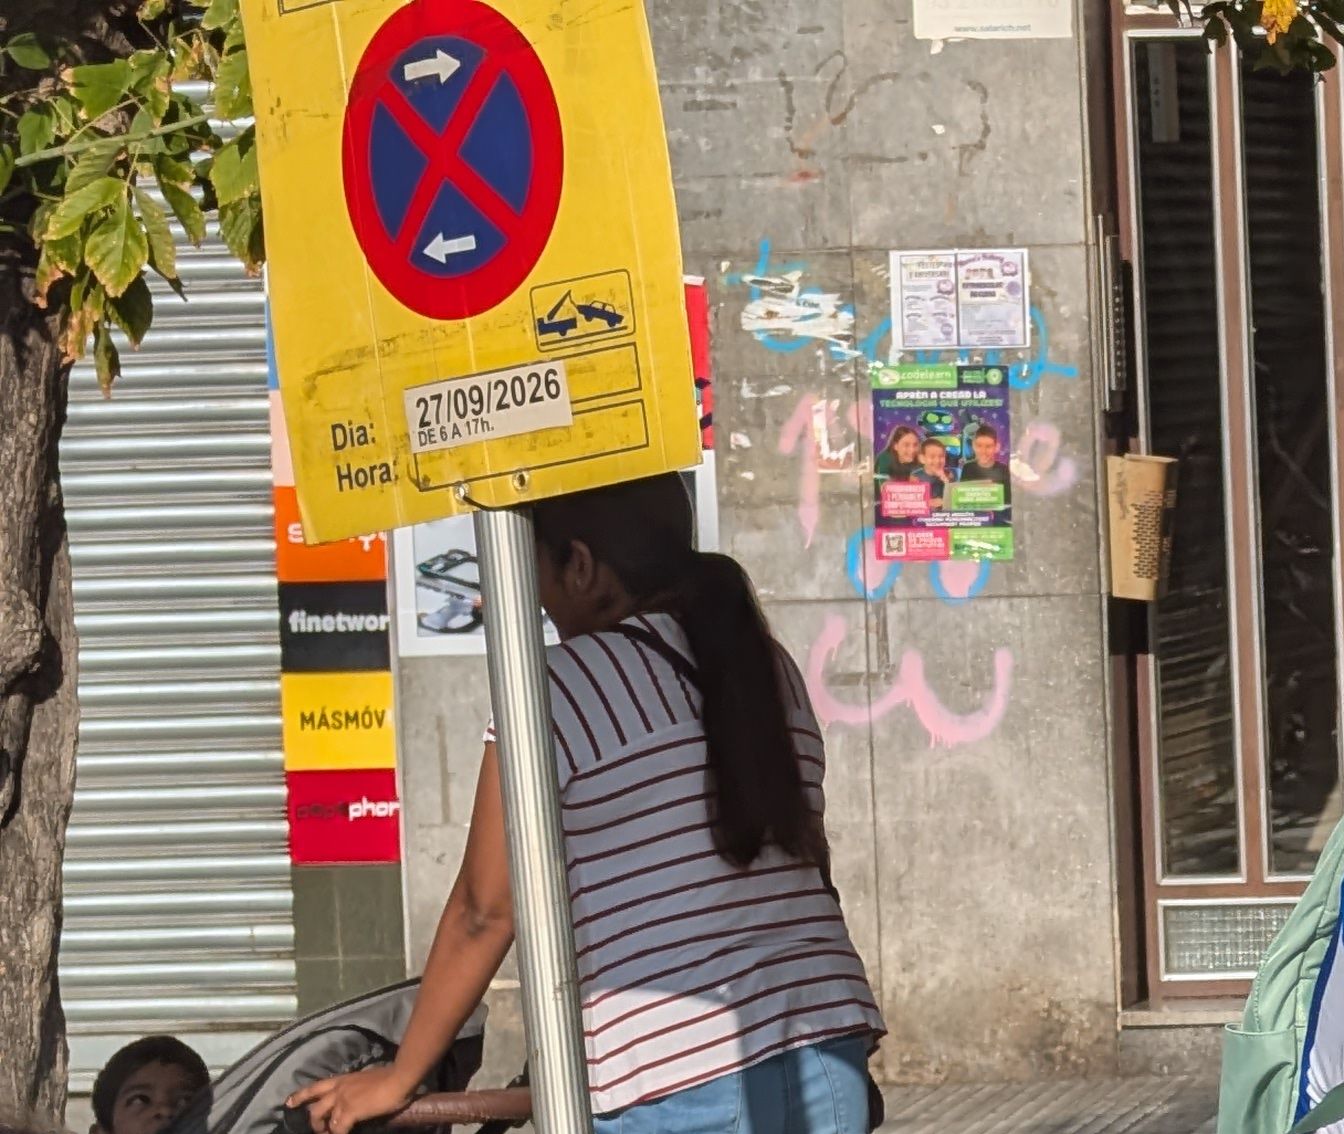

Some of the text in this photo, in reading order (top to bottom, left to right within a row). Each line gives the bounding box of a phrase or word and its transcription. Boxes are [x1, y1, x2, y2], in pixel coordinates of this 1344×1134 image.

[415, 367, 562, 429] 27/09/2026
[331, 420, 376, 451] Dia:
[418, 417, 495, 447] DE 6 A 17h.
[336, 457, 398, 492] Hora:
[288, 610, 390, 634] finetwor
[299, 706, 392, 732] MÁSMÓV
